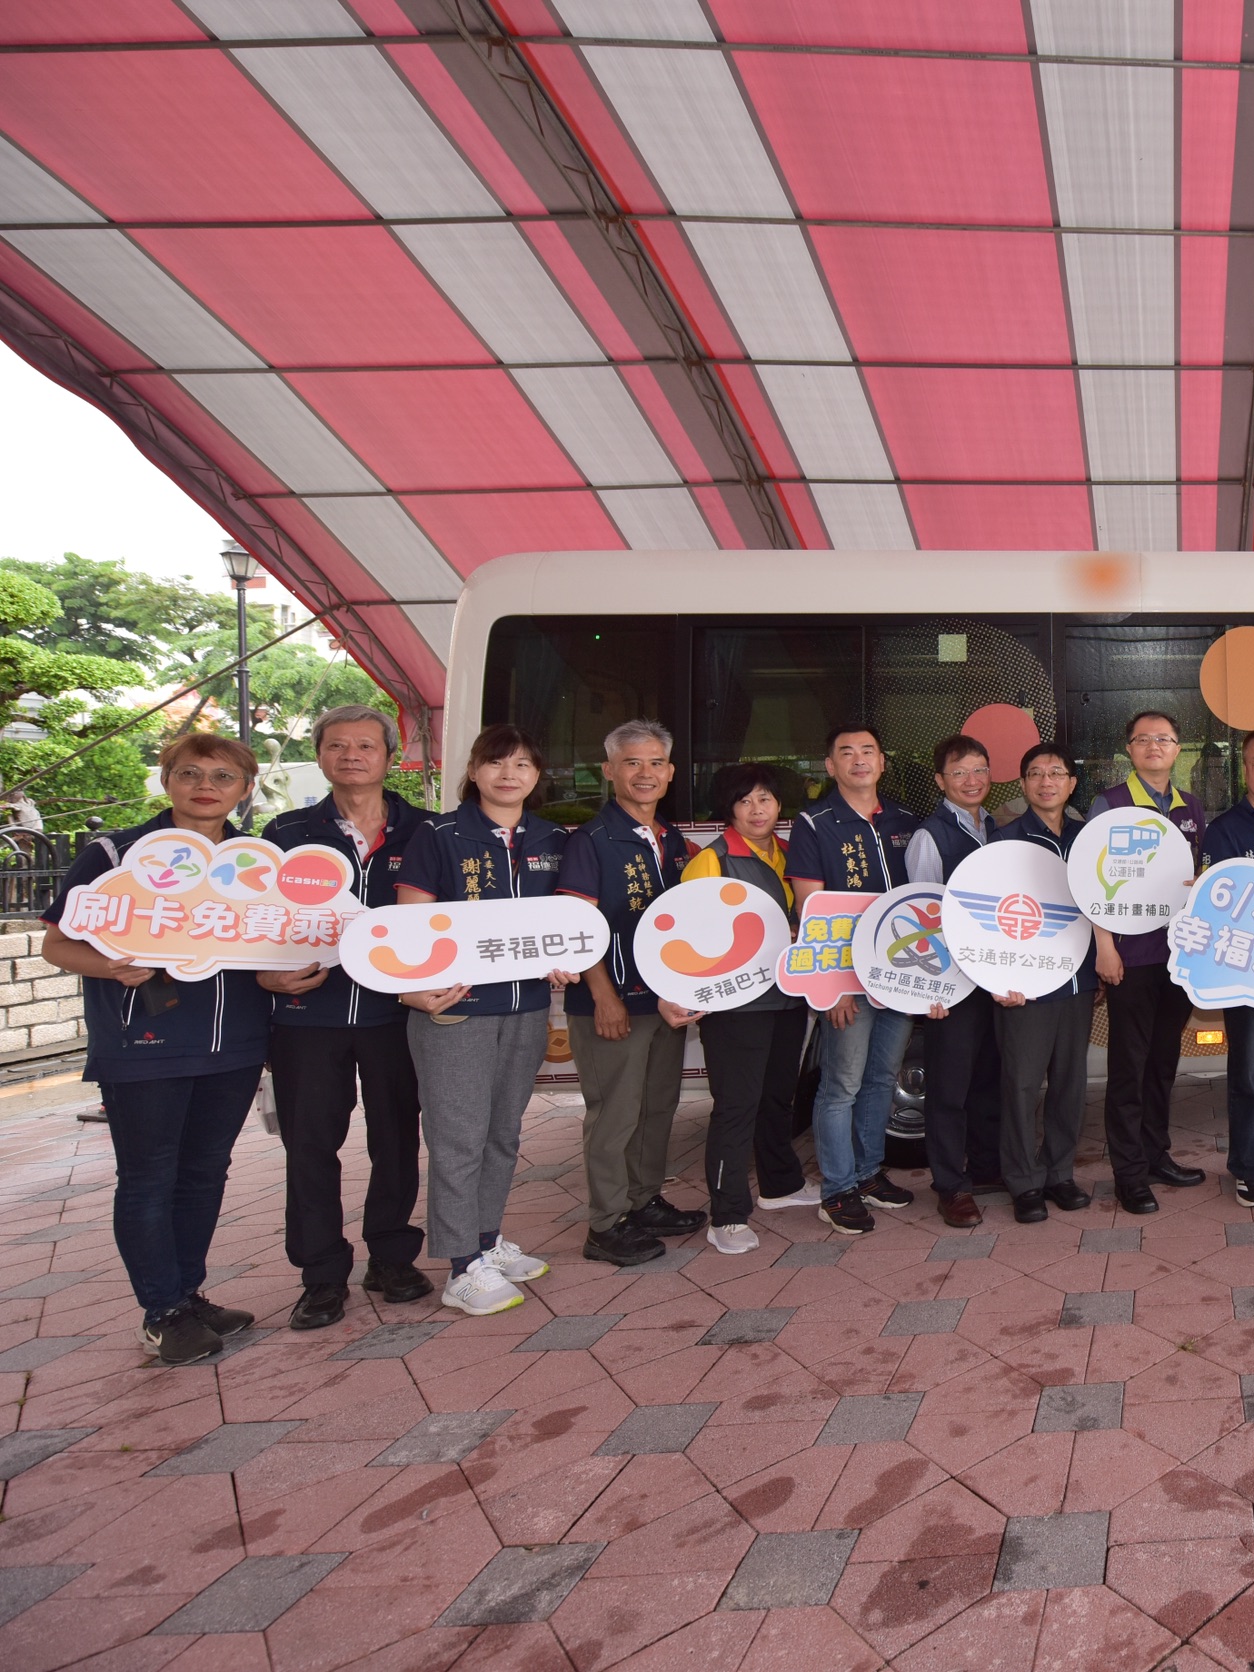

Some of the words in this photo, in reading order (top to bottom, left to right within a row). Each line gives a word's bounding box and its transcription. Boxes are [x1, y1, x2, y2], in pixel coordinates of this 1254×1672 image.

[1090, 902, 1171, 917] 公運計畫補助
[805, 917, 862, 942] 免費
[476, 931, 594, 963] 幸福巴士
[958, 946, 1075, 972] 交通部公路局
[694, 966, 773, 1004] 幸福巴士
[867, 966, 956, 997] 臺中區監理所
[868, 981, 893, 993] Taichung
[893, 986, 910, 995] Motor
[910, 990, 934, 1000] Vehicles
[934, 995, 951, 1003] Office
